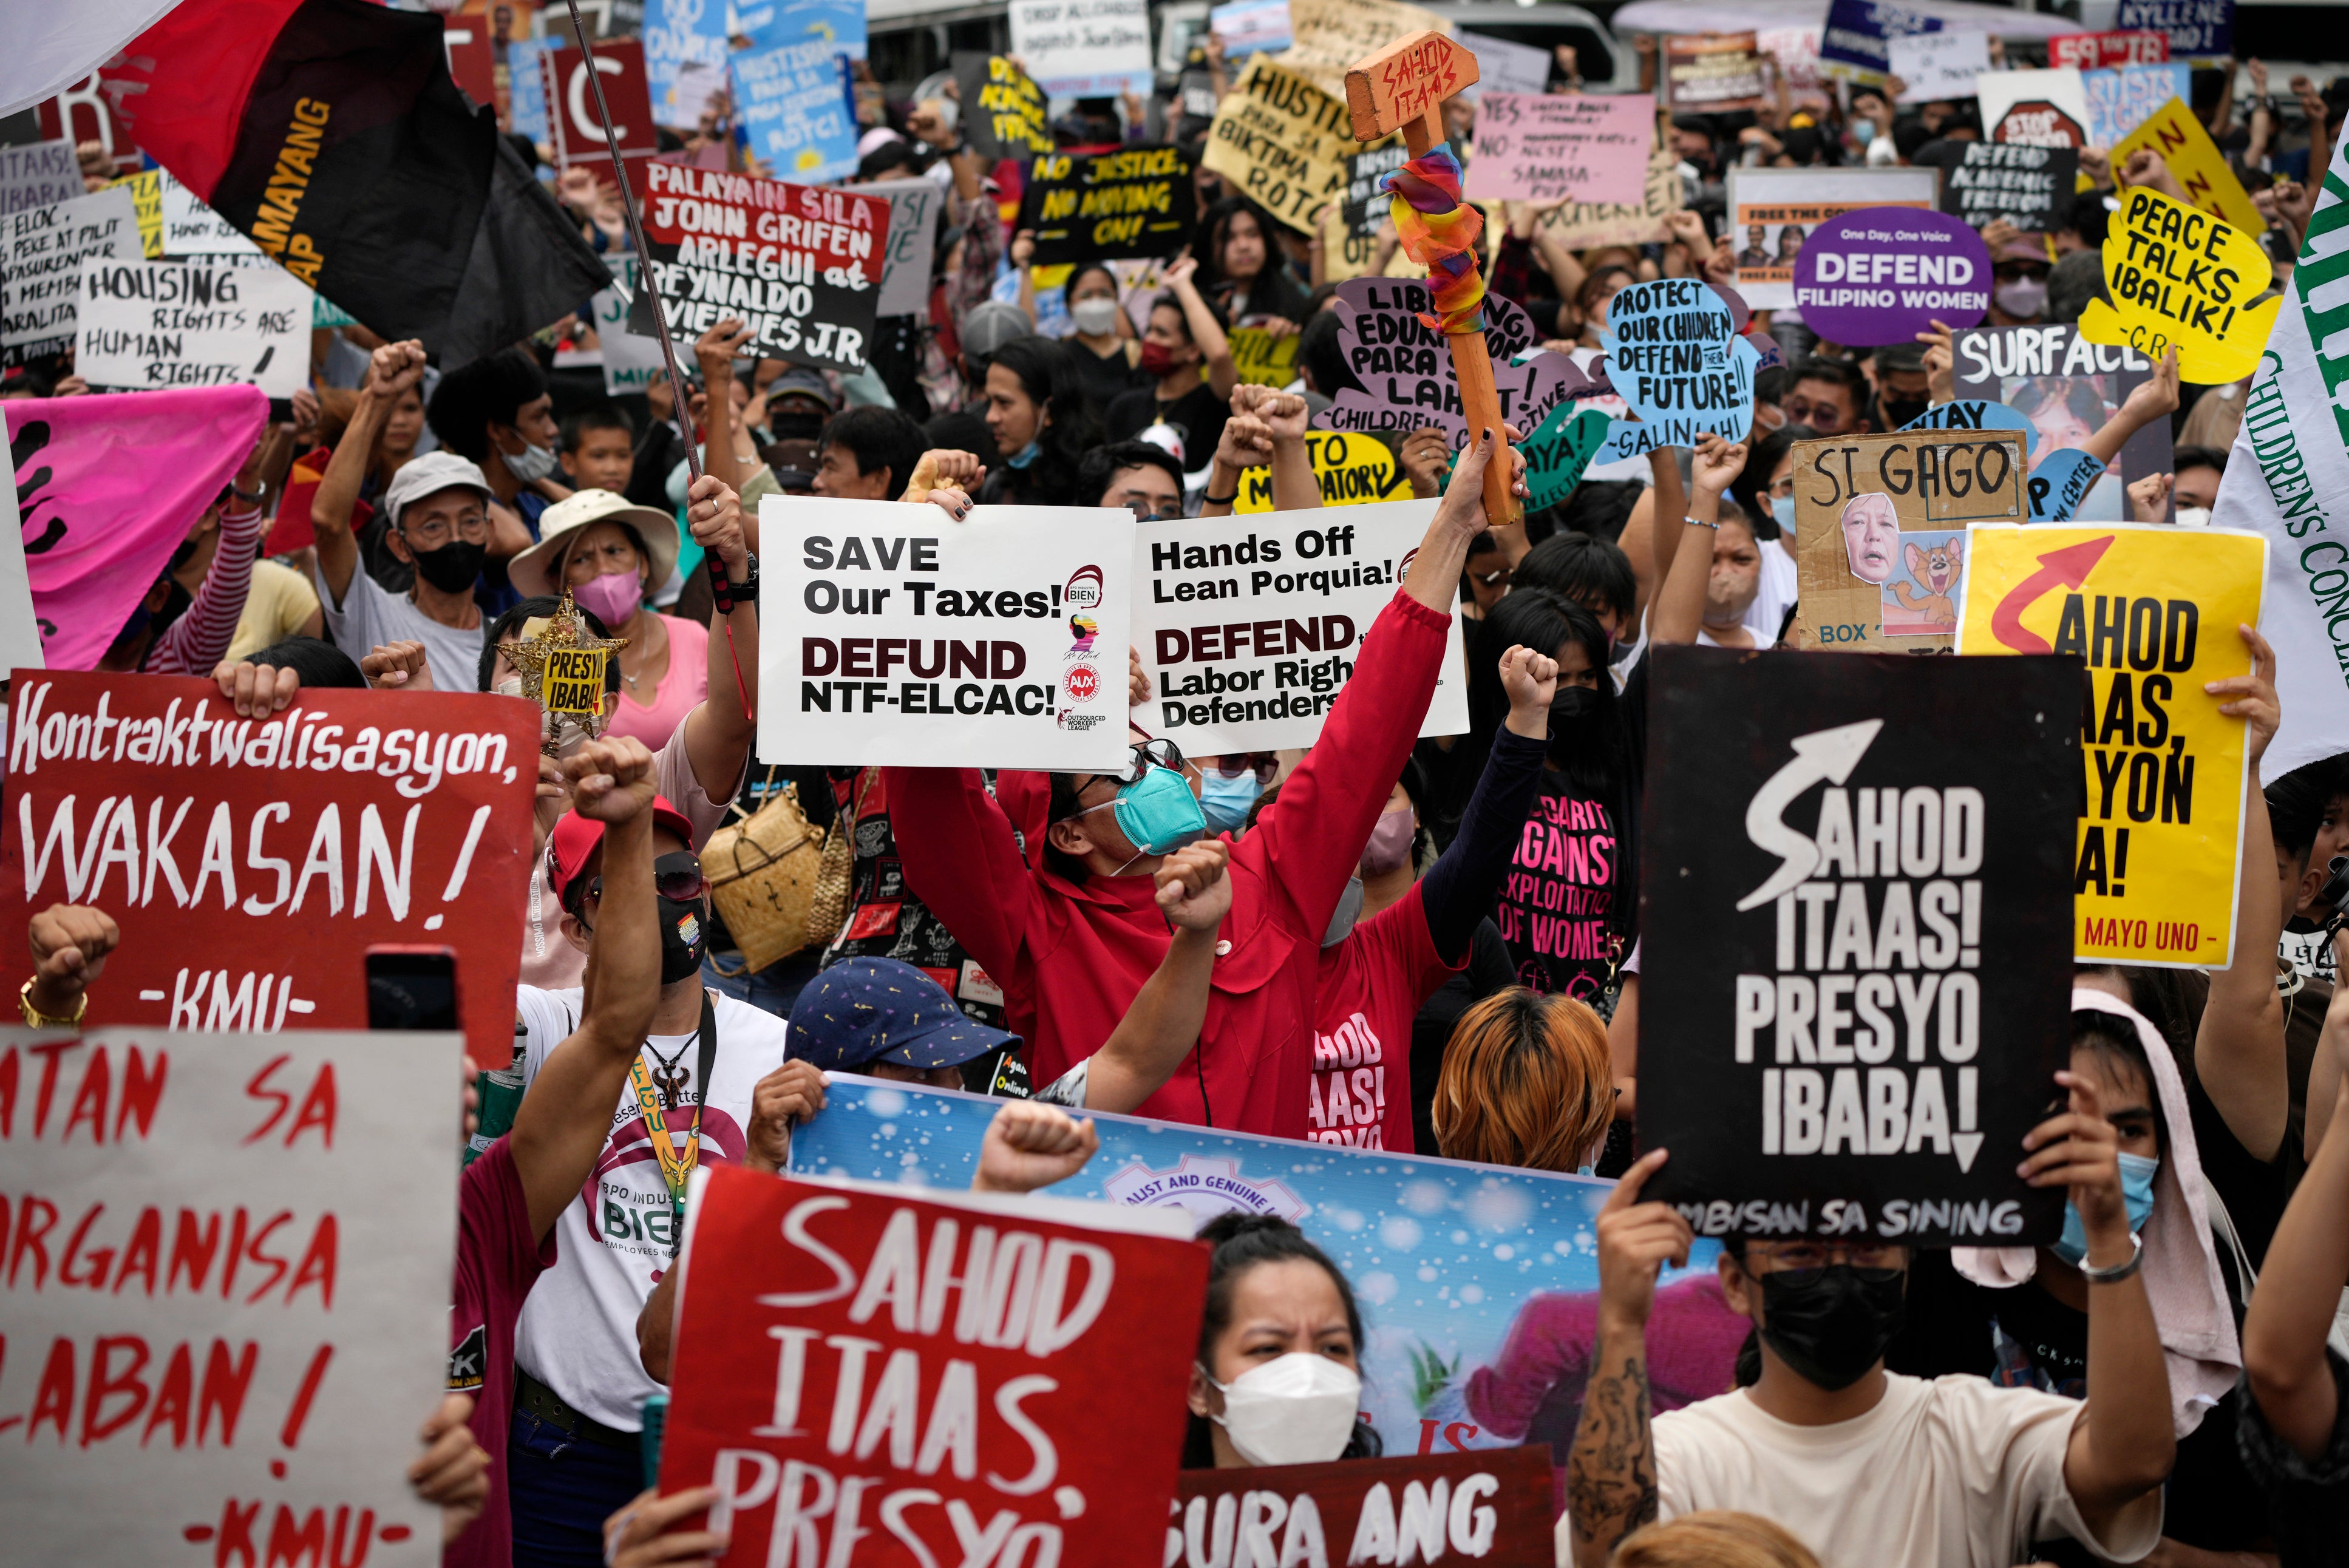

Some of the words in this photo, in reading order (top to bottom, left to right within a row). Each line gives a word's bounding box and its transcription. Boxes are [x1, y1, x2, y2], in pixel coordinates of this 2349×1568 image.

[1383, 38, 1453, 98] SAHOD
[1395, 60, 1457, 121] ITAAS
[1032, 155, 1072, 182] NO
[648, 163, 787, 212] PALAYAIN
[800, 187, 873, 229] SILA
[1040, 188, 1077, 222] NO
[756, 211, 872, 259] GRIFEN
[1840, 228, 1864, 240] One
[1866, 229, 1894, 243] Day,
[1895, 230, 1918, 242] One
[1920, 230, 1951, 243] Voice
[2127, 194, 2232, 262] PEACE
[677, 235, 816, 287] ARLEGUI
[823, 257, 870, 291] at
[1815, 253, 1974, 285] DEFEND
[2127, 231, 2240, 304] TALKS
[89, 266, 239, 306] HOUSING
[640, 258, 814, 318] REYNALDO
[1612, 280, 1702, 318] PROTECT
[1797, 287, 1896, 308] FILIPINO
[1901, 290, 1989, 310] WOMEN
[2112, 262, 2237, 341] IBALIK!
[85, 327, 183, 359] HUMAN
[151, 308, 246, 331] RIGHTS
[256, 308, 296, 338] ARE
[1618, 316, 1661, 342] OUR
[1663, 307, 1731, 342] CHILDREN
[1351, 347, 1437, 375] PARA
[1618, 343, 1702, 375] DEFEND
[1704, 351, 1725, 364] THEIR
[1523, 450, 1590, 511] OLLECTIVE
[1811, 447, 1860, 506] SI
[1880, 442, 2008, 498] GAGO
[2061, 456, 2101, 508] CENTER
[803, 535, 939, 572] SAVE
[1152, 534, 1282, 571] Hands
[1295, 525, 1355, 560] Off
[803, 580, 890, 614] Our
[903, 582, 1061, 619] Taxes!
[1070, 590, 1095, 600] BIEN
[1154, 577, 1239, 603] Lean
[1251, 559, 1393, 596] Porquia!
[1155, 614, 1355, 665] DEFEND
[1820, 623, 1867, 642] BOX
[548, 649, 603, 680] PRESYO
[802, 637, 1027, 679] DEFUND
[1077, 650, 1101, 660] Glad
[548, 682, 602, 716] IBABA!
[801, 681, 1055, 716] NTF-ELCAC!
[1069, 674, 1094, 689] AUX
[1160, 667, 1264, 698] Labor
[1163, 691, 1337, 728] Defenders
[9, 680, 518, 798] Kontraktwalisasyon,
[2081, 750, 2196, 825] YON
[531, 872, 542, 920] INTERNATIONAL
[533, 922, 546, 959] MOSSIMO
[1498, 901, 1525, 943] OF
[1775, 880, 1982, 972] ITAAS!
[2084, 916, 2147, 949] MAYO
[2156, 922, 2200, 952] UNO
[139, 968, 316, 1034] -KMU-
[1735, 973, 1981, 1064] PRESYO
[238, 1051, 339, 1151] SA
[996, 1075, 1028, 1098] Online
[1762, 1065, 1985, 1175] IBABA!
[603, 1182, 629, 1200] BPO
[1169, 1174, 1200, 1189] AND
[1205, 1175, 1268, 1210] GENUINE
[603, 1198, 673, 1246] BIE
[1668, 1198, 1810, 1236] MBISAN
[1816, 1198, 1869, 1236] SA
[1877, 1198, 2025, 1237] SINING
[605, 1241, 659, 1257] EMPLOYEES
[755, 1193, 1116, 1359] SAHOD
[750, 1324, 1087, 1521] ITAAS,
[181, 1496, 412, 1568] -KMU-
[1347, 1473, 1500, 1567] ANG
